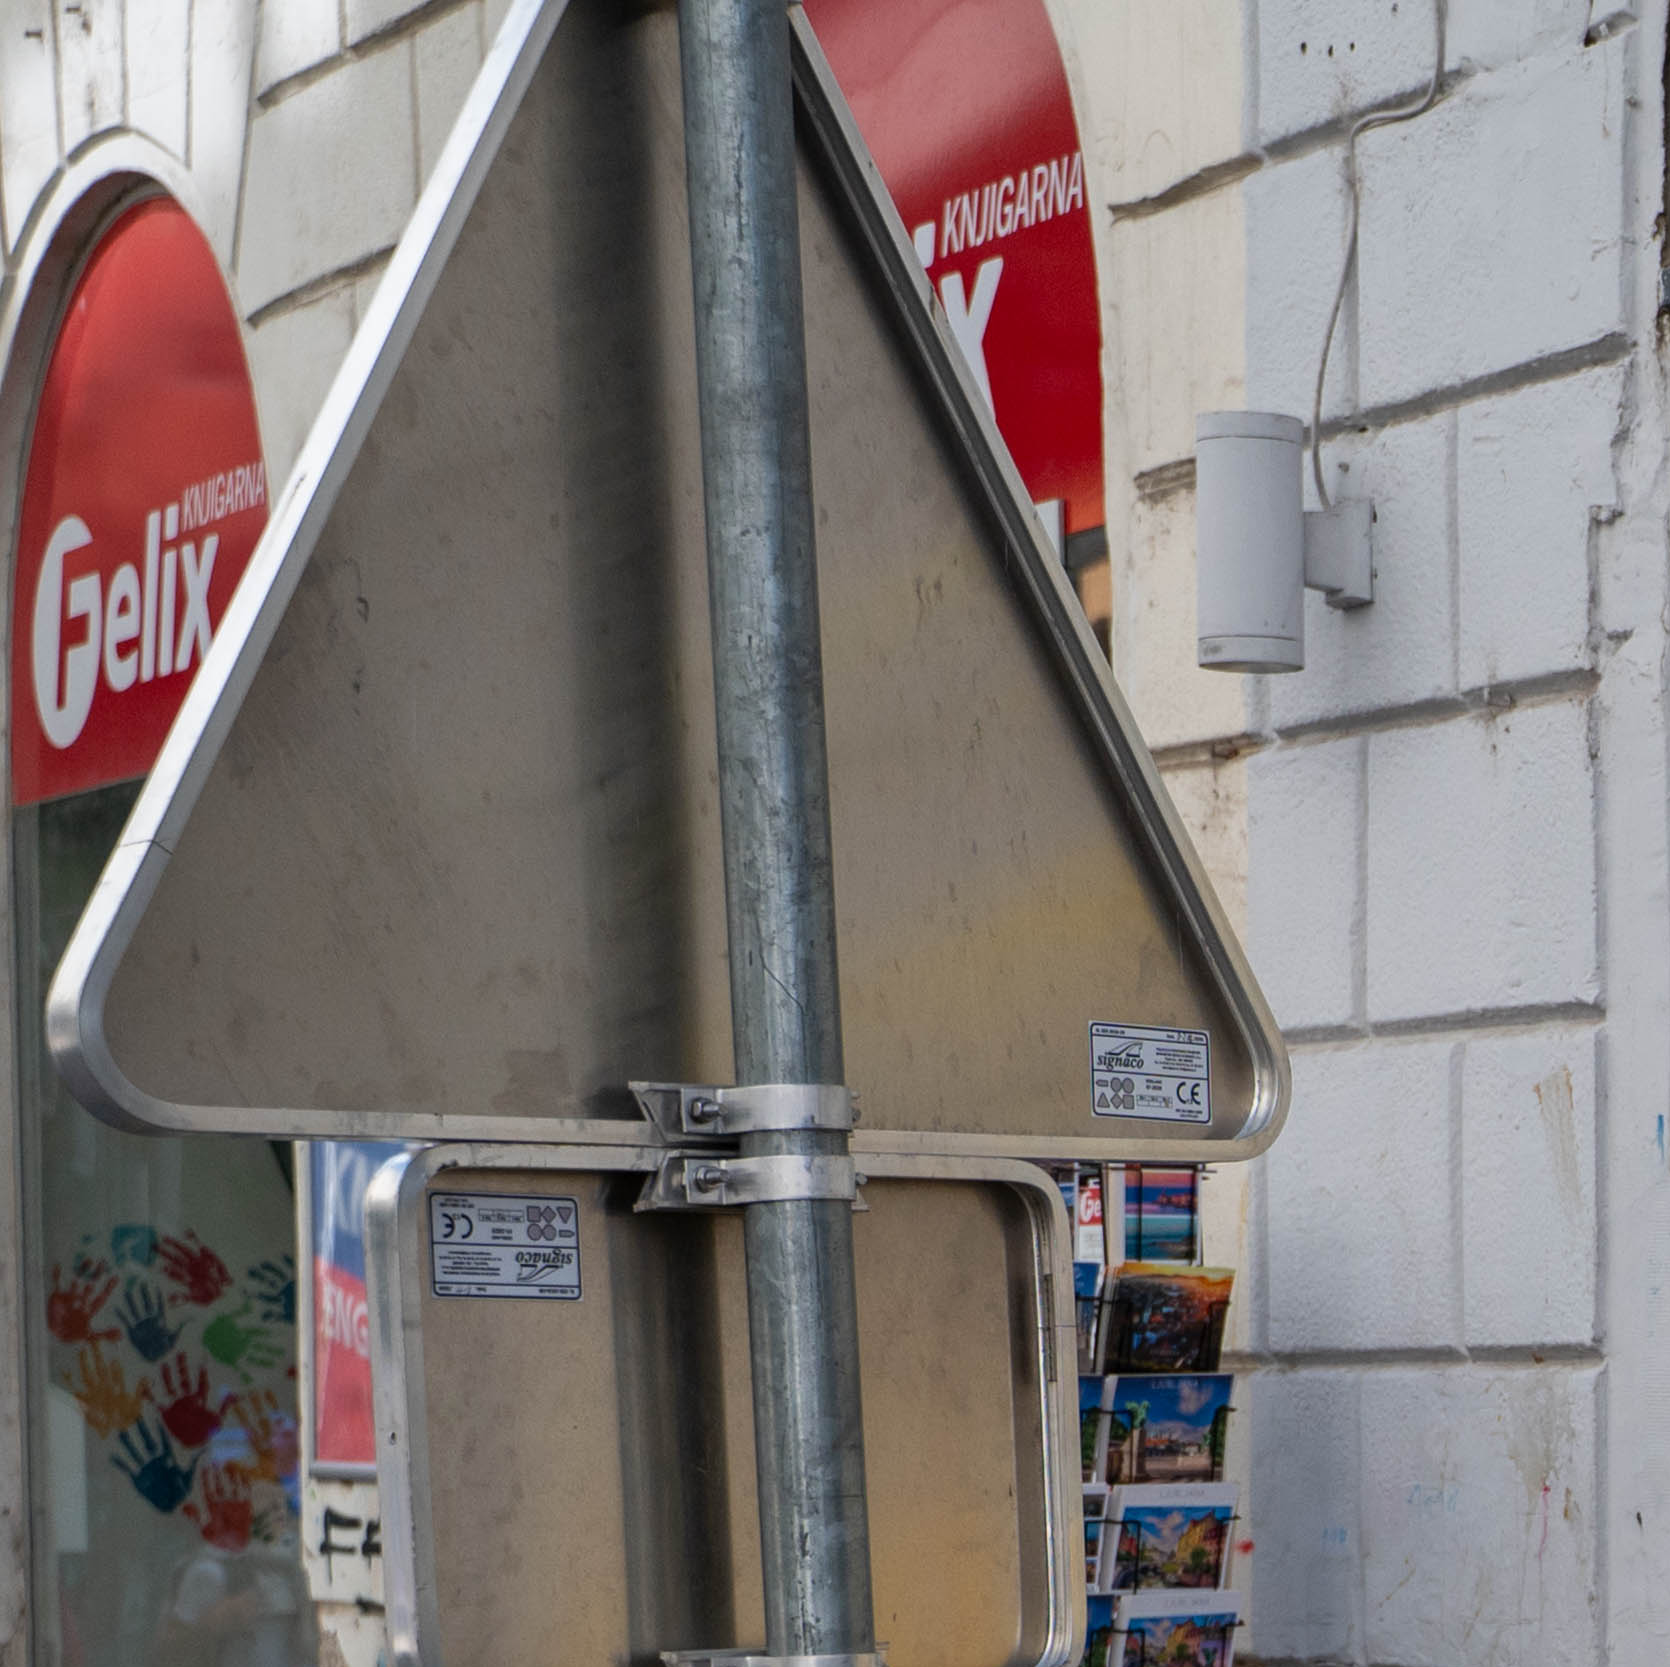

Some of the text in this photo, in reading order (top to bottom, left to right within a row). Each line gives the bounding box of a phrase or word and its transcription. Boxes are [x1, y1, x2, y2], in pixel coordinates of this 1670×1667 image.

[942, 152, 1085, 258] KNJIGARNA
[181, 461, 267, 531] KNJIGARNA
[32, 503, 220, 749] Felix
[1097, 1053, 1144, 1070] signaco
[515, 1248, 574, 1269] signaco
